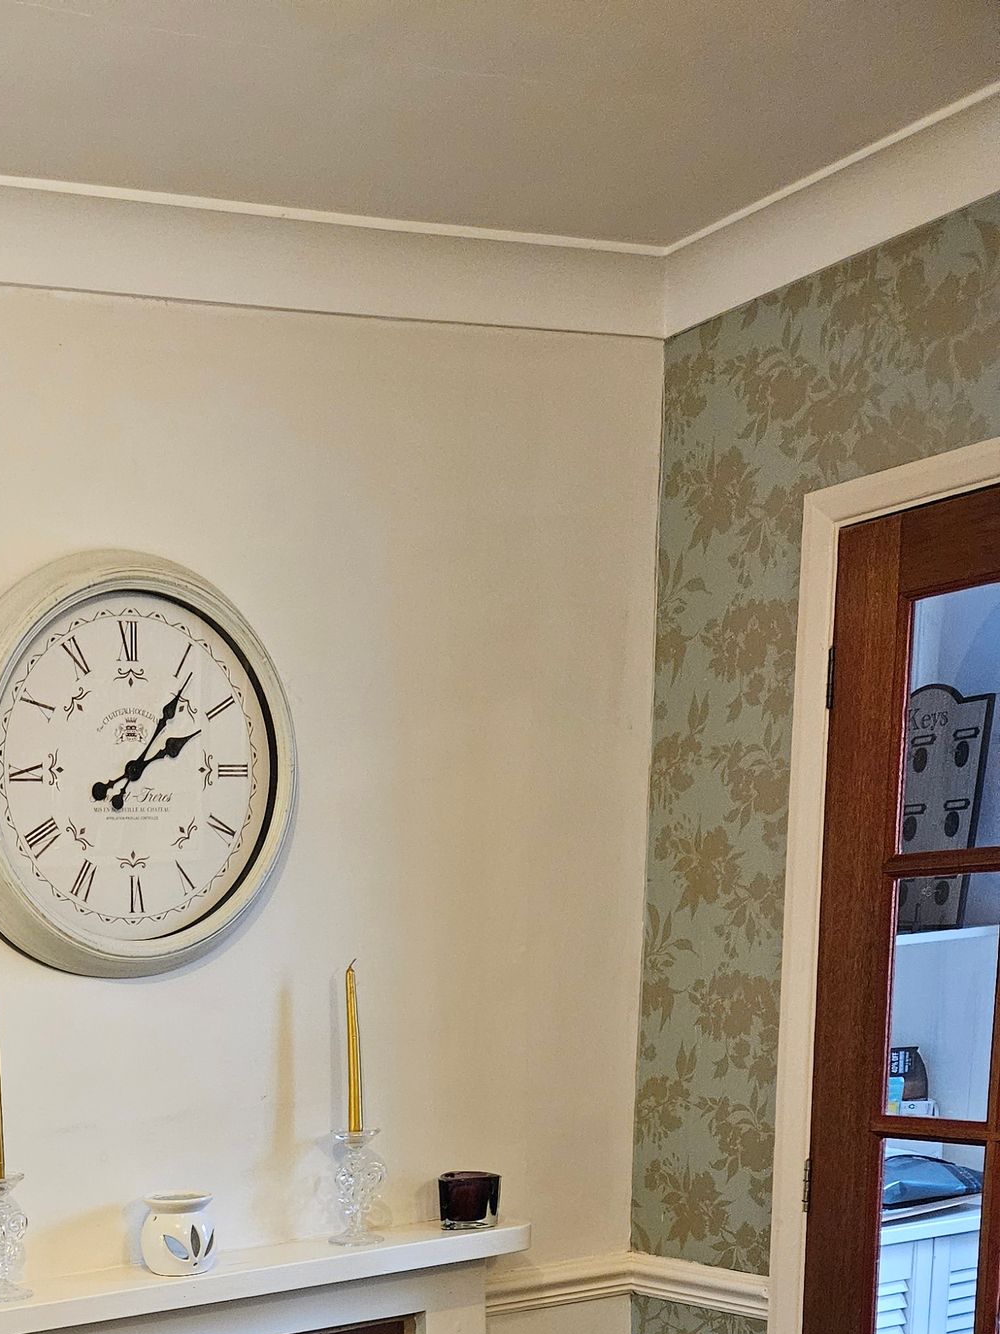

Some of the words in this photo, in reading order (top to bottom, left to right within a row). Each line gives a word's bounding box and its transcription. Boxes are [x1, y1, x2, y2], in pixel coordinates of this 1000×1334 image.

[60, 635, 91, 682] XI
[116, 620, 139, 662] XII
[172, 643, 193, 678] I
[20, 688, 55, 722] X
[205, 693, 235, 722] II
[908, 708, 949, 731] Keys
[8, 762, 44, 783] IX
[217, 762, 249, 779] III
[24, 815, 62, 859] VIII
[206, 813, 236, 848] IV
[70, 858, 98, 903] VII
[128, 875, 146, 914] VI
[174, 859, 196, 896] V
